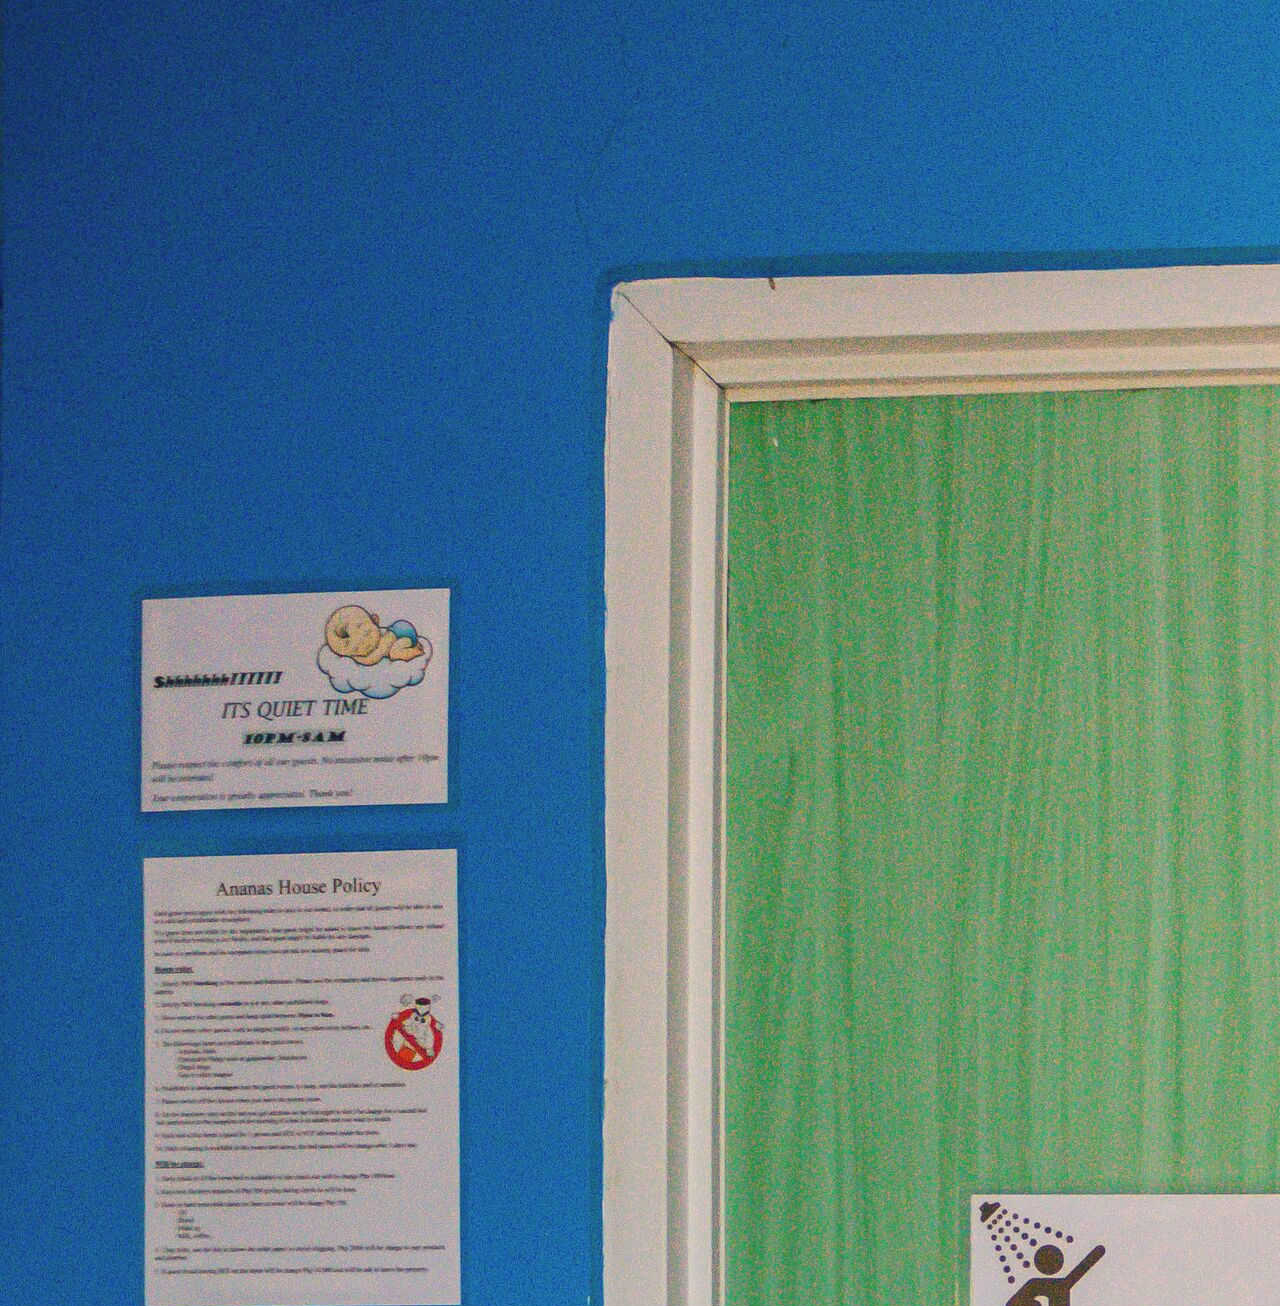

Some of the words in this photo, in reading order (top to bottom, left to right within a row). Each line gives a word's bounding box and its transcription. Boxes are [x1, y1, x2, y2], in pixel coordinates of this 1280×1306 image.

[221, 701, 252, 719] ITS
[257, 699, 318, 721] QUIET
[323, 698, 370, 716] TIME
[216, 881, 273, 897] Ananas
[278, 879, 327, 895] House
[332, 877, 382, 897] Policy
